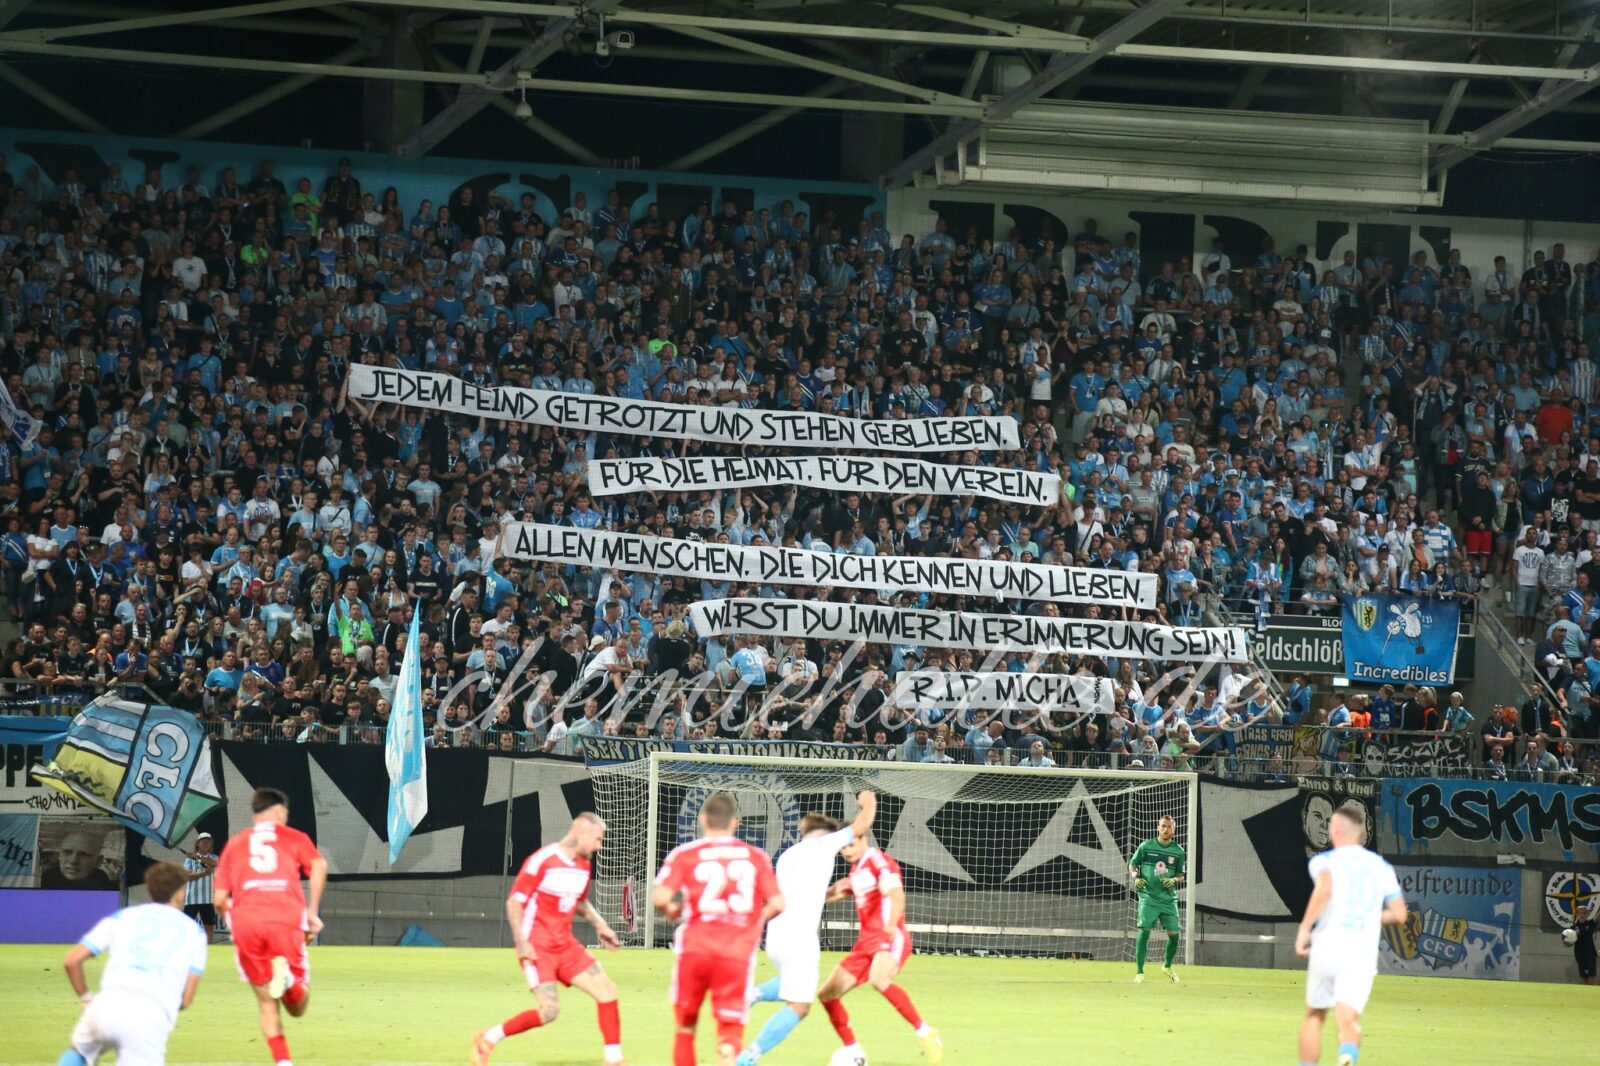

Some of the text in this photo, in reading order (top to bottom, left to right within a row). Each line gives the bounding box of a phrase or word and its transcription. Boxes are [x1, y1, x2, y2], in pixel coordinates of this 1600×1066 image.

[361, 370, 1008, 448] JEDEM FEIND GETROTZT UND STEHEN GEBLIEBEN.
[600, 461, 662, 488] FÜR
[662, 459, 706, 488] DIE
[820, 456, 880, 486] FÜR
[884, 462, 937, 490] DEN
[942, 467, 1048, 501] VEREIN.
[515, 524, 596, 563] ALLEN
[760, 549, 804, 580] DIE
[811, 553, 876, 583] DICH
[883, 558, 982, 592] KENNEN
[991, 565, 1043, 597] UND
[703, 599, 1236, 660] WIRST DU IMMER IN ERINNERUNG SEIN!
[1322, 619, 1342, 628] BLOC
[1353, 661, 1447, 682] Incredibles
[910, 674, 1080, 708] R.I.P. MICHA
[1297, 776, 1330, 791] Enno
[249, 832, 279, 874] 5
[694, 860, 756, 913] 23
[1401, 868, 1514, 900] elfreunde
[1422, 938, 1456, 958] CFC
